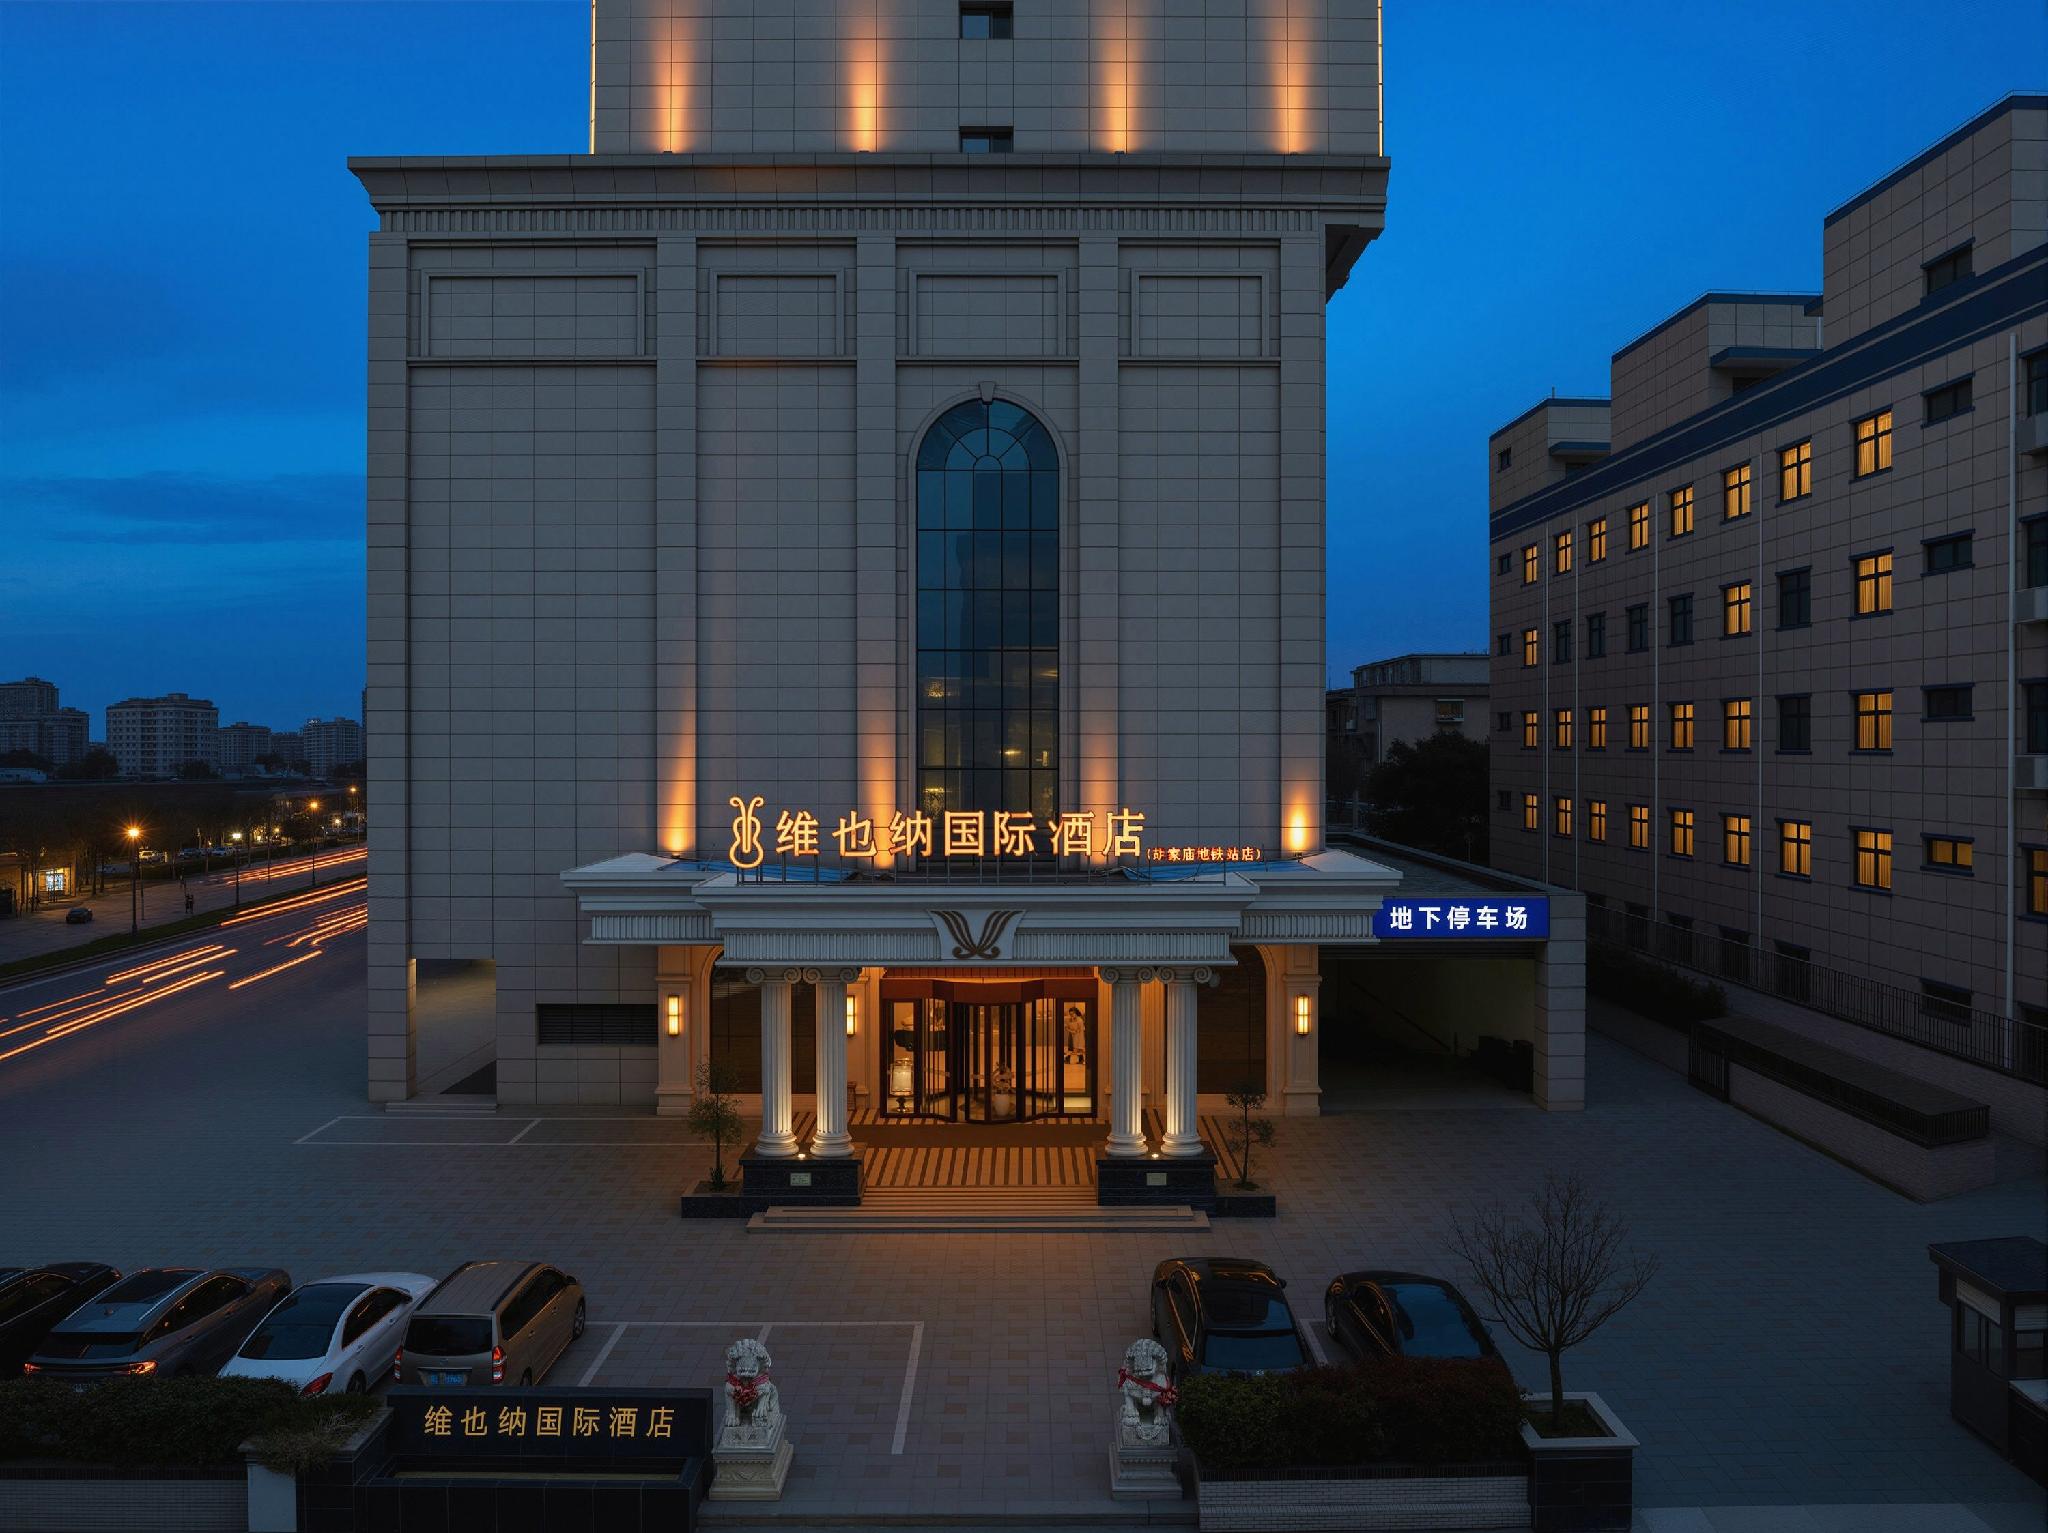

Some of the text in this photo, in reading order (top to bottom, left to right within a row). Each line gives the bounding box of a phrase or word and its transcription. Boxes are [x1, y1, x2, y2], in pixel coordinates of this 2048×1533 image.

[775, 809, 1146, 857] 维也纳国际酒店
[1390, 905, 1528, 930] 地下停车场
[424, 1405, 675, 1438] 维也纳国际酒店
